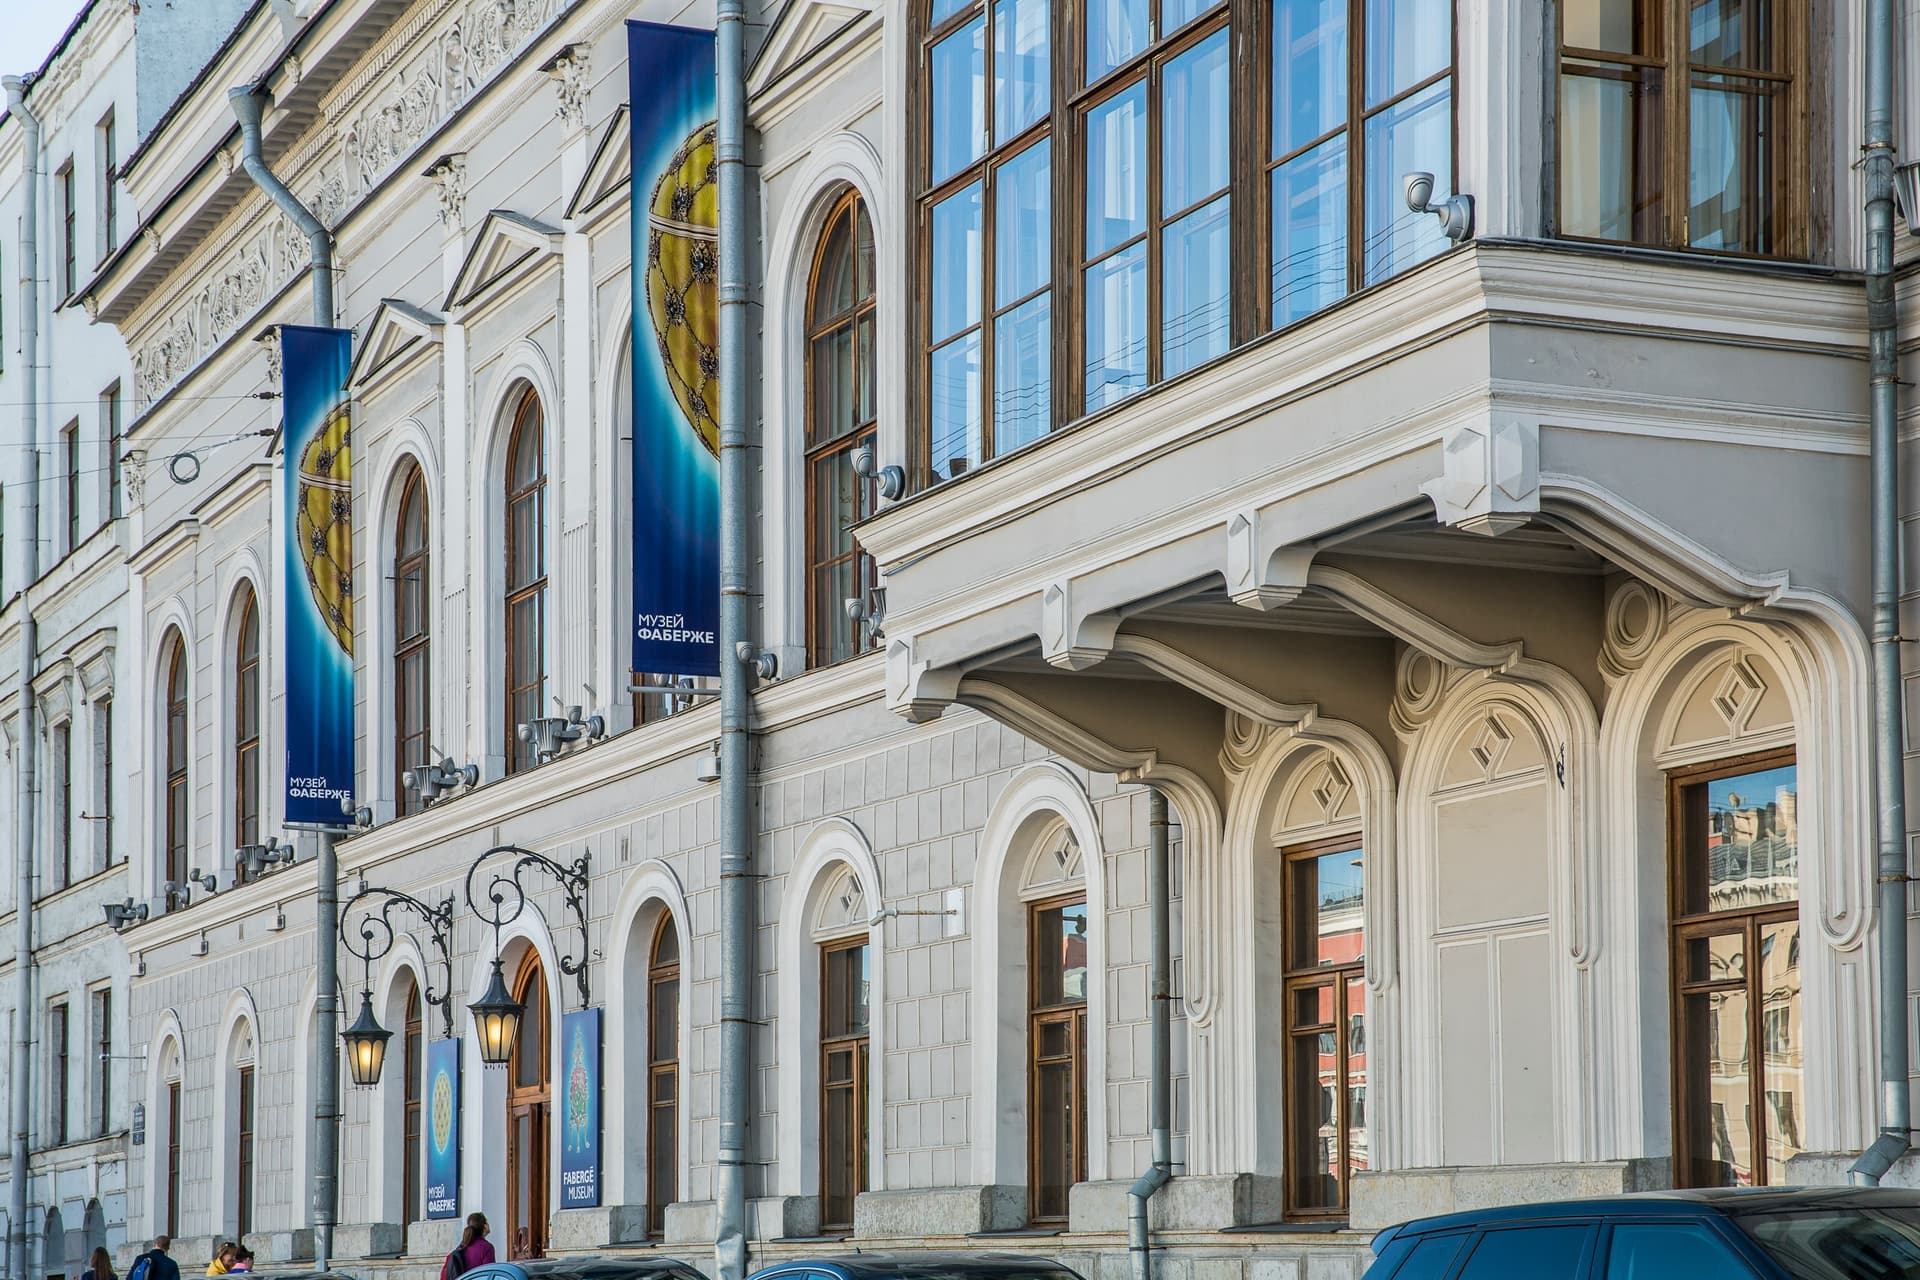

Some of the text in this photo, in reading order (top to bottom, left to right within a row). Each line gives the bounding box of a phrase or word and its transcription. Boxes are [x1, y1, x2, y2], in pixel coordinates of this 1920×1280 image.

[638, 613, 684, 629] МУЗЕЙ
[638, 627, 714, 644] ФАБЕРЖЕ
[290, 776, 327, 788] МУЗЕЙ
[289, 788, 351, 800] ФАБЕРЖЕ
[563, 1165, 594, 1185] FABERGÉ
[428, 1183, 445, 1200] МУЗЕЙ
[568, 1185, 594, 1200] MUSEUM
[428, 1198, 456, 1212] ФАБЕРЖЕ
